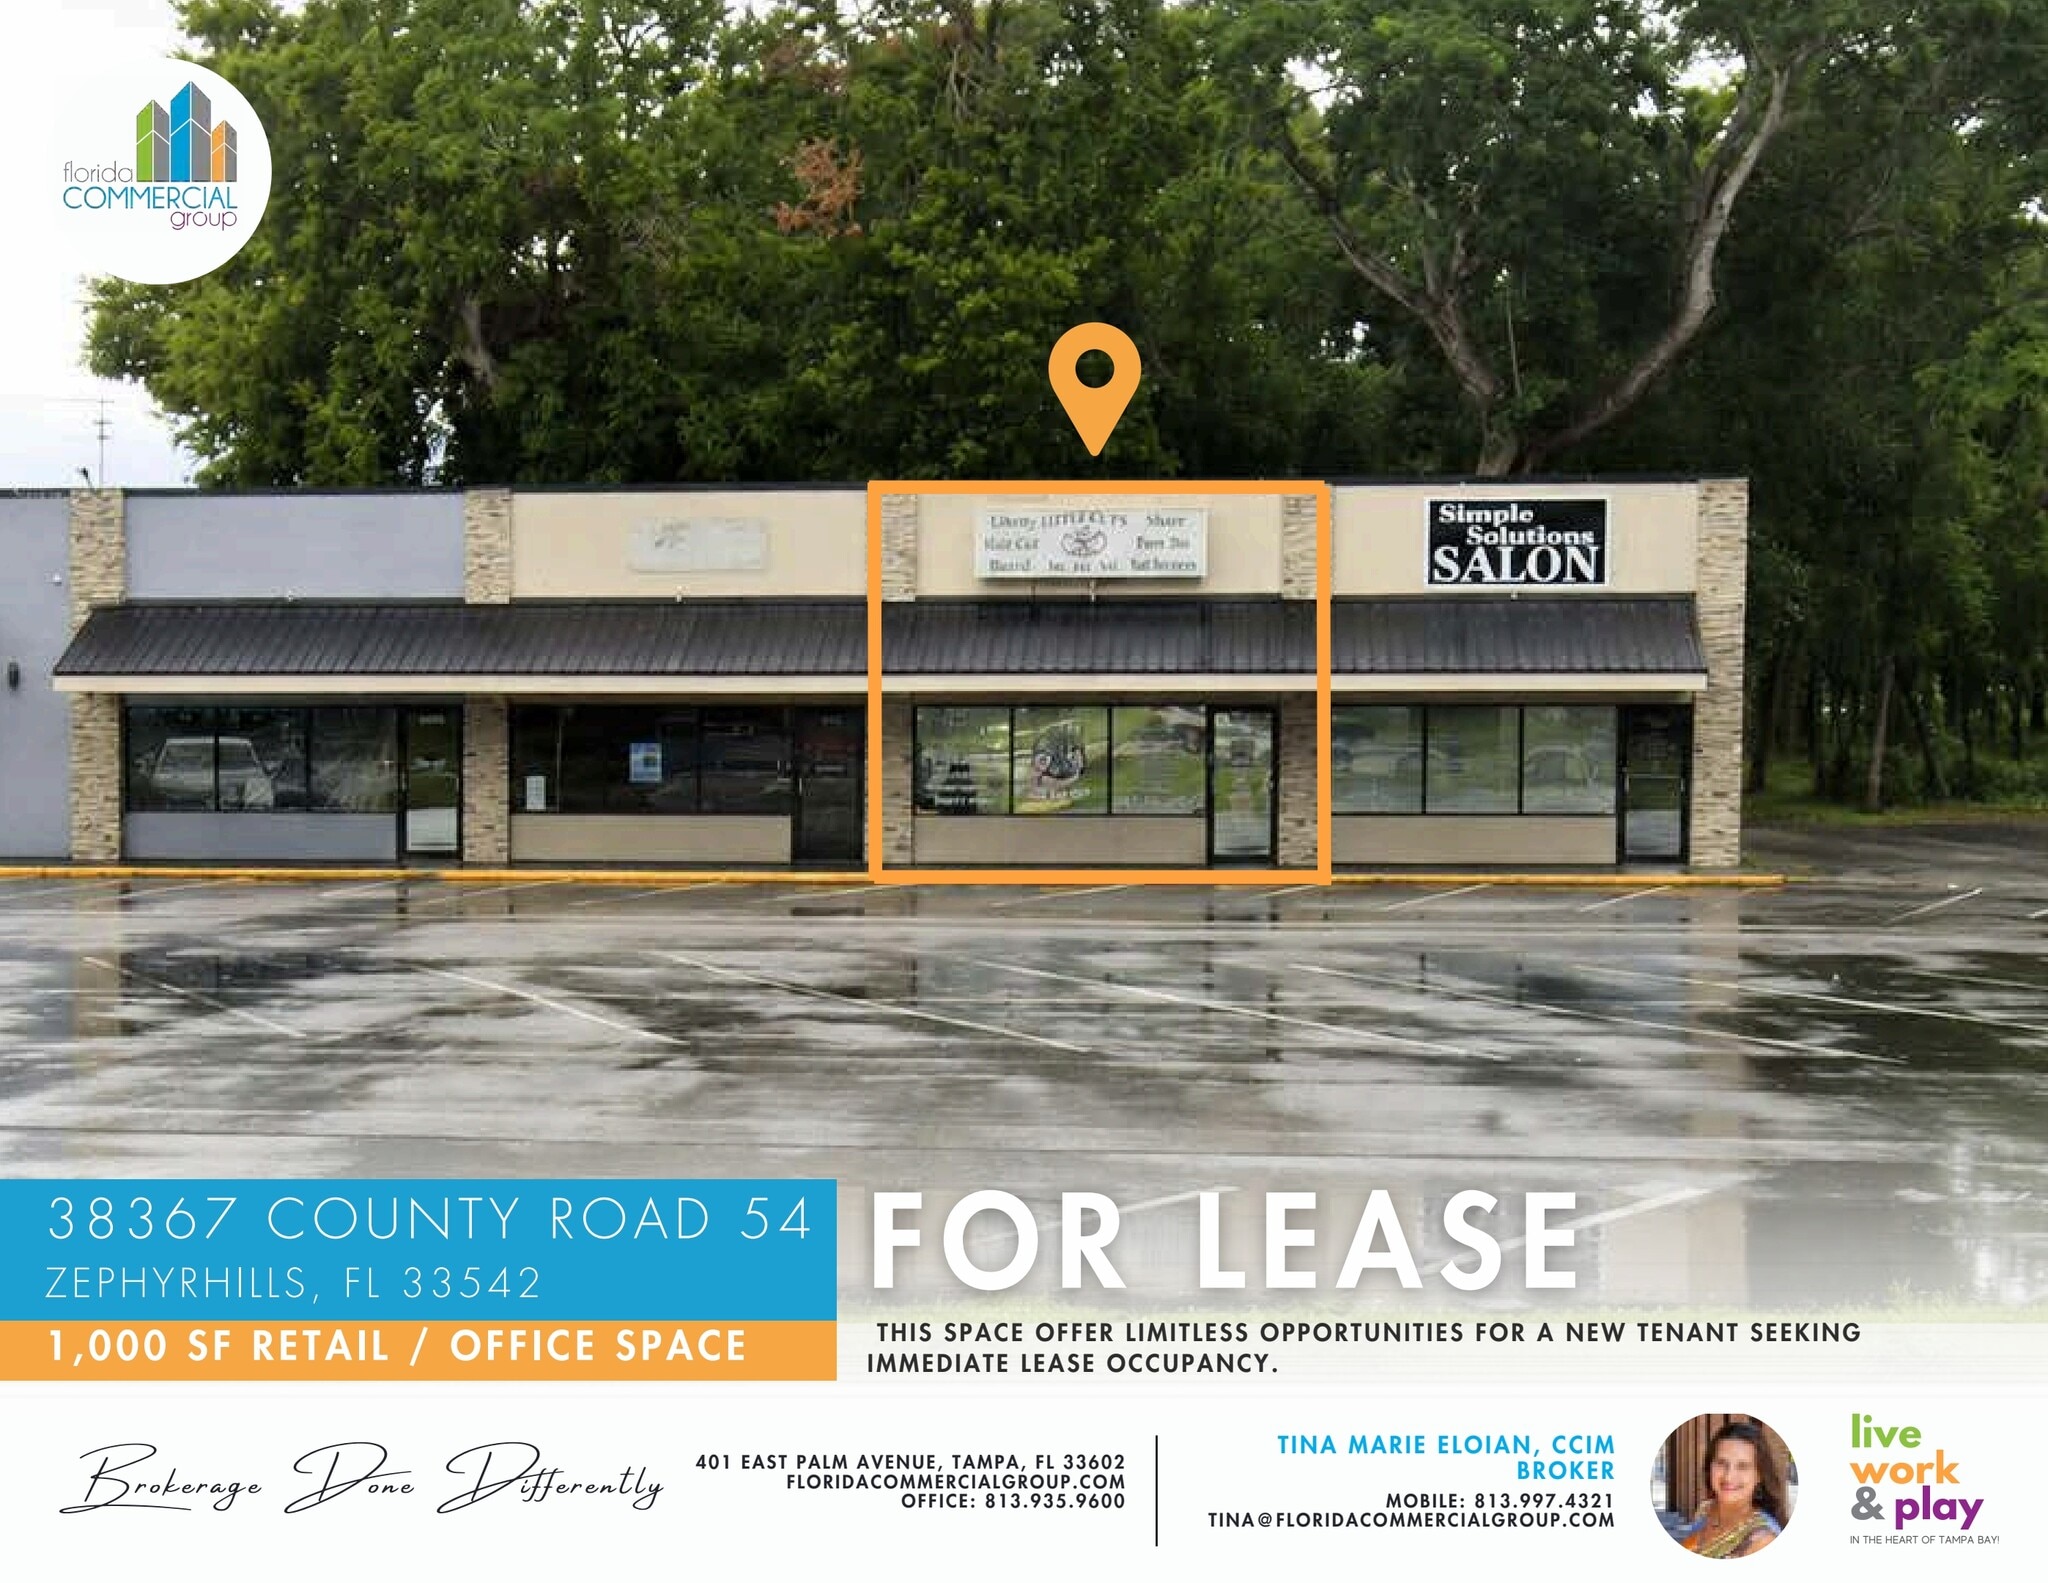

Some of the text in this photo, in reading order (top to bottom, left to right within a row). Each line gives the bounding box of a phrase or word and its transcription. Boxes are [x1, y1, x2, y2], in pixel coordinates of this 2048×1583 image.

[1438, 503, 1535, 527] Simple
[1466, 524, 1596, 546] Solutions
[1432, 545, 1600, 583] SALON
